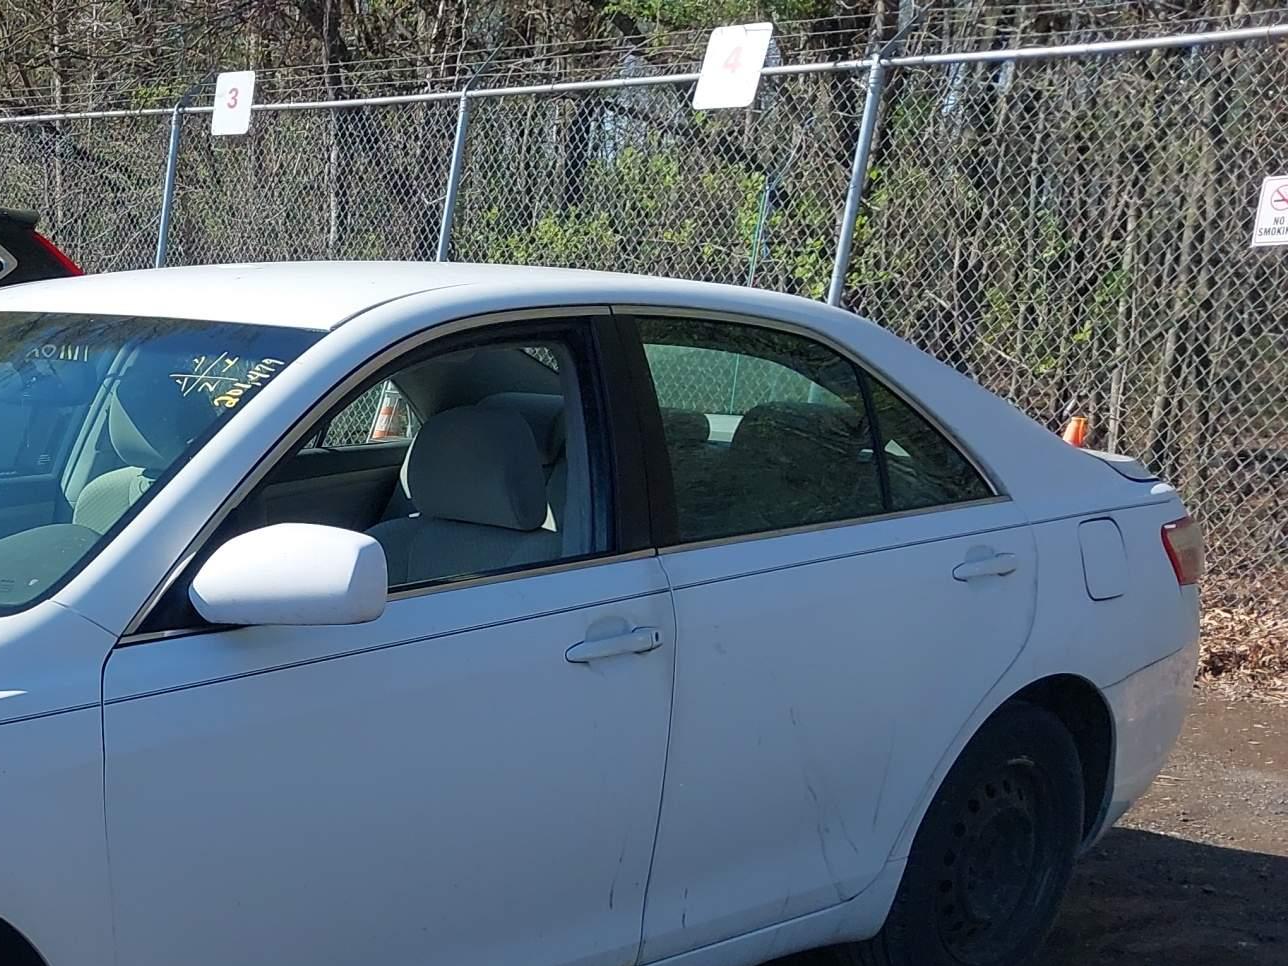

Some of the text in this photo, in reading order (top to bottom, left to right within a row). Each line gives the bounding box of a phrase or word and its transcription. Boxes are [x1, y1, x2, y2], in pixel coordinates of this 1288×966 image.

[722, 46, 743, 73] 4
[227, 87, 239, 109] 3
[1273, 216, 1285, 225] NO
